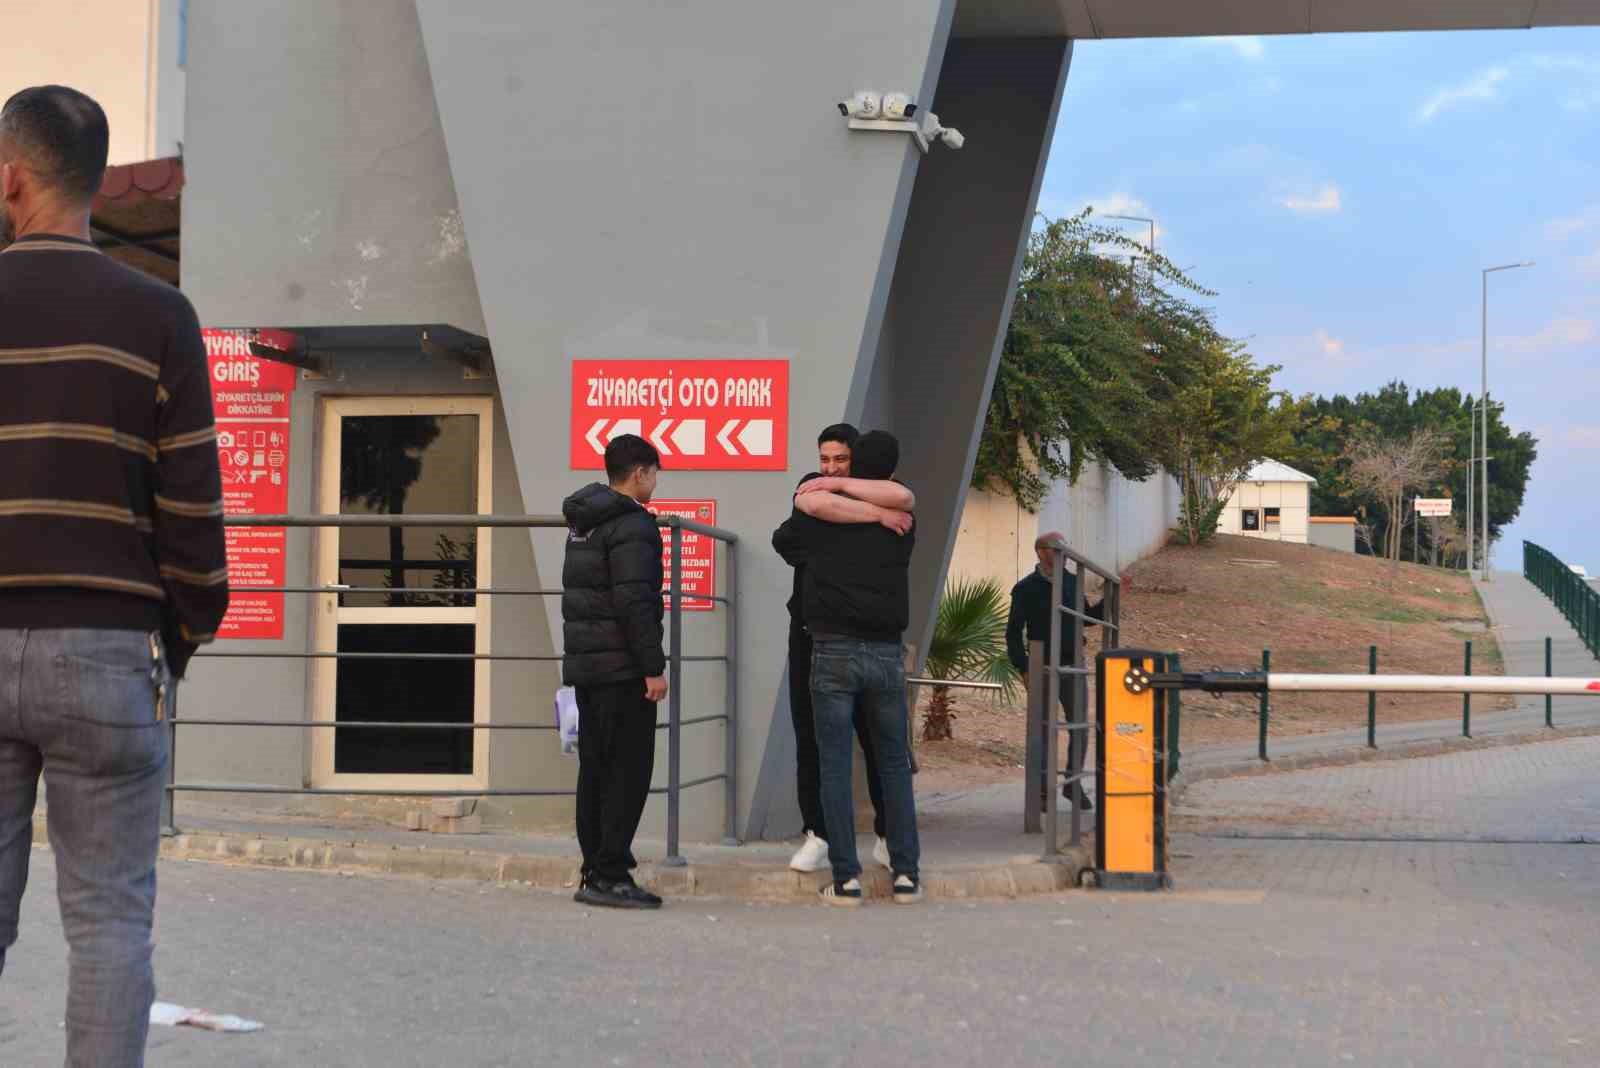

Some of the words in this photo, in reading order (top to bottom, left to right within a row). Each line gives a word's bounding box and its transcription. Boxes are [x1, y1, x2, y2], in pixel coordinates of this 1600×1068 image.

[214, 357, 260, 388] GİRİŞ
[586, 370, 673, 415] ZİYARETÇİ
[679, 378, 719, 407] OTO
[725, 378, 772, 407] PARK
